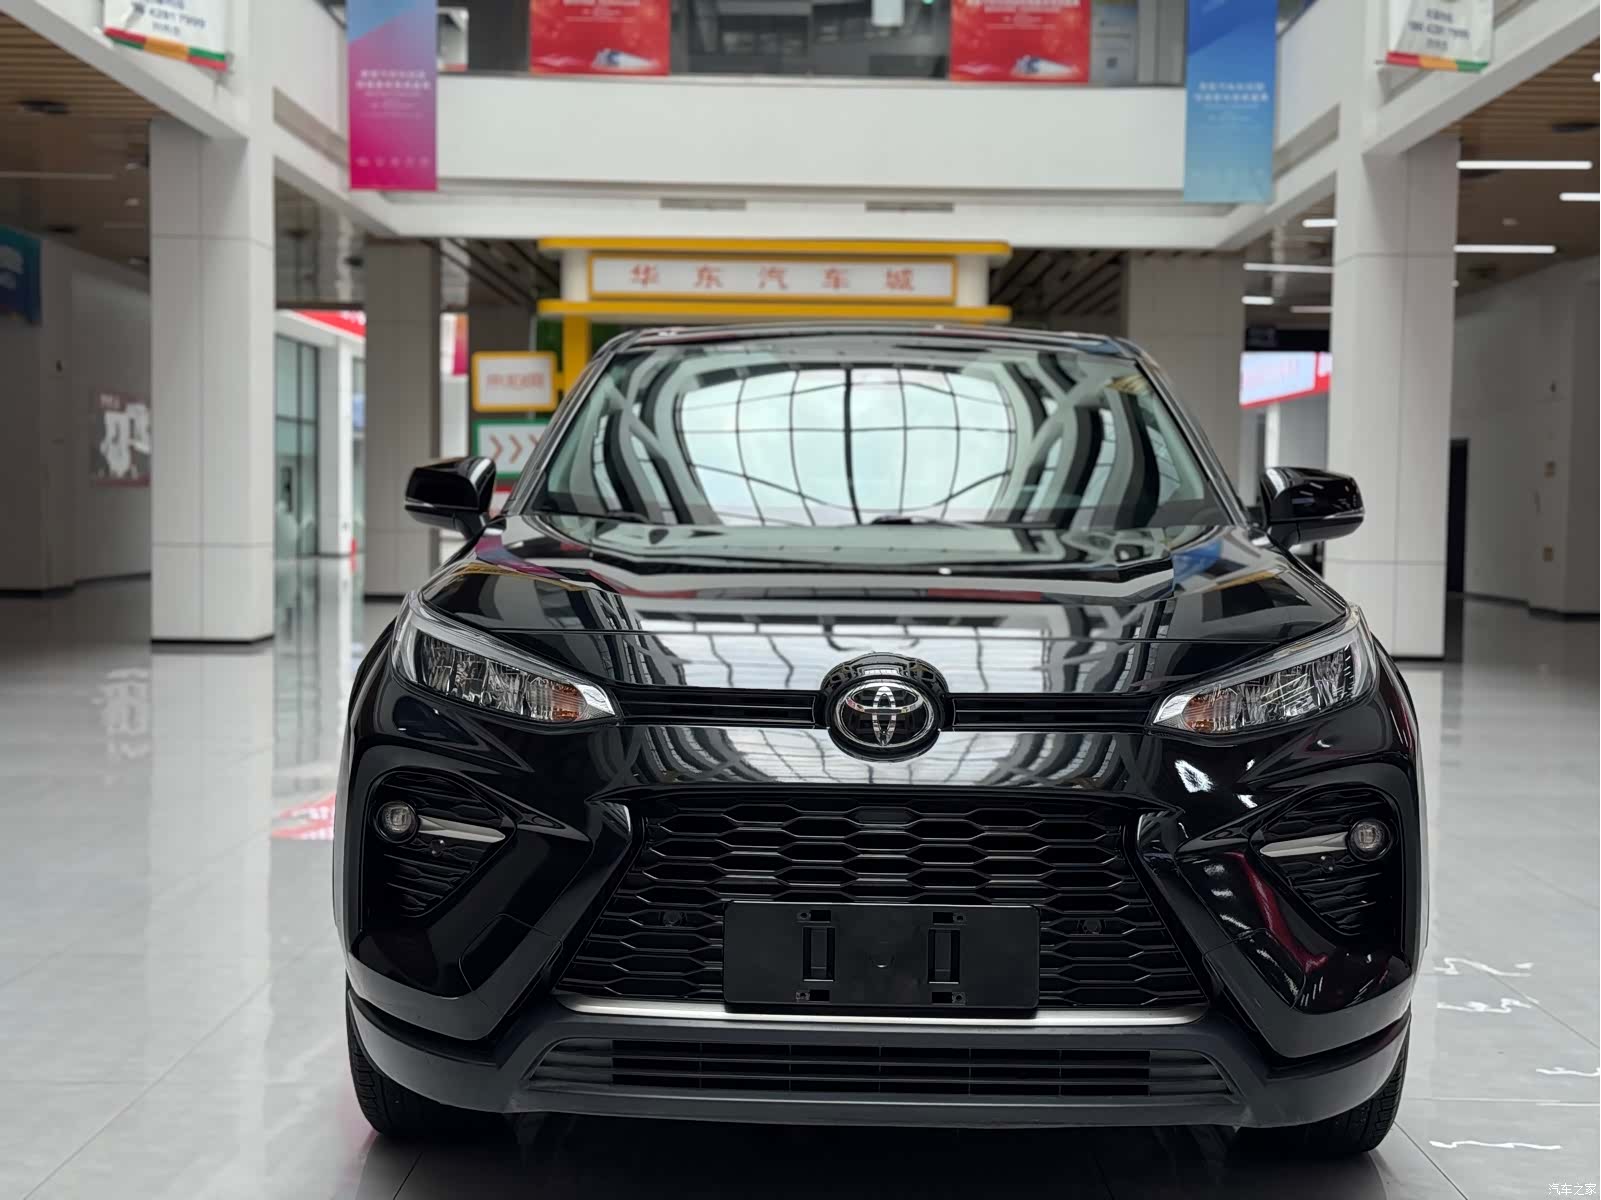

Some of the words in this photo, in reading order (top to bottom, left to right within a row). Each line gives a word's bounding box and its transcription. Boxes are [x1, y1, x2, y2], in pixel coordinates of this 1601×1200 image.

[630, 264, 915, 292] 华东汽车城
